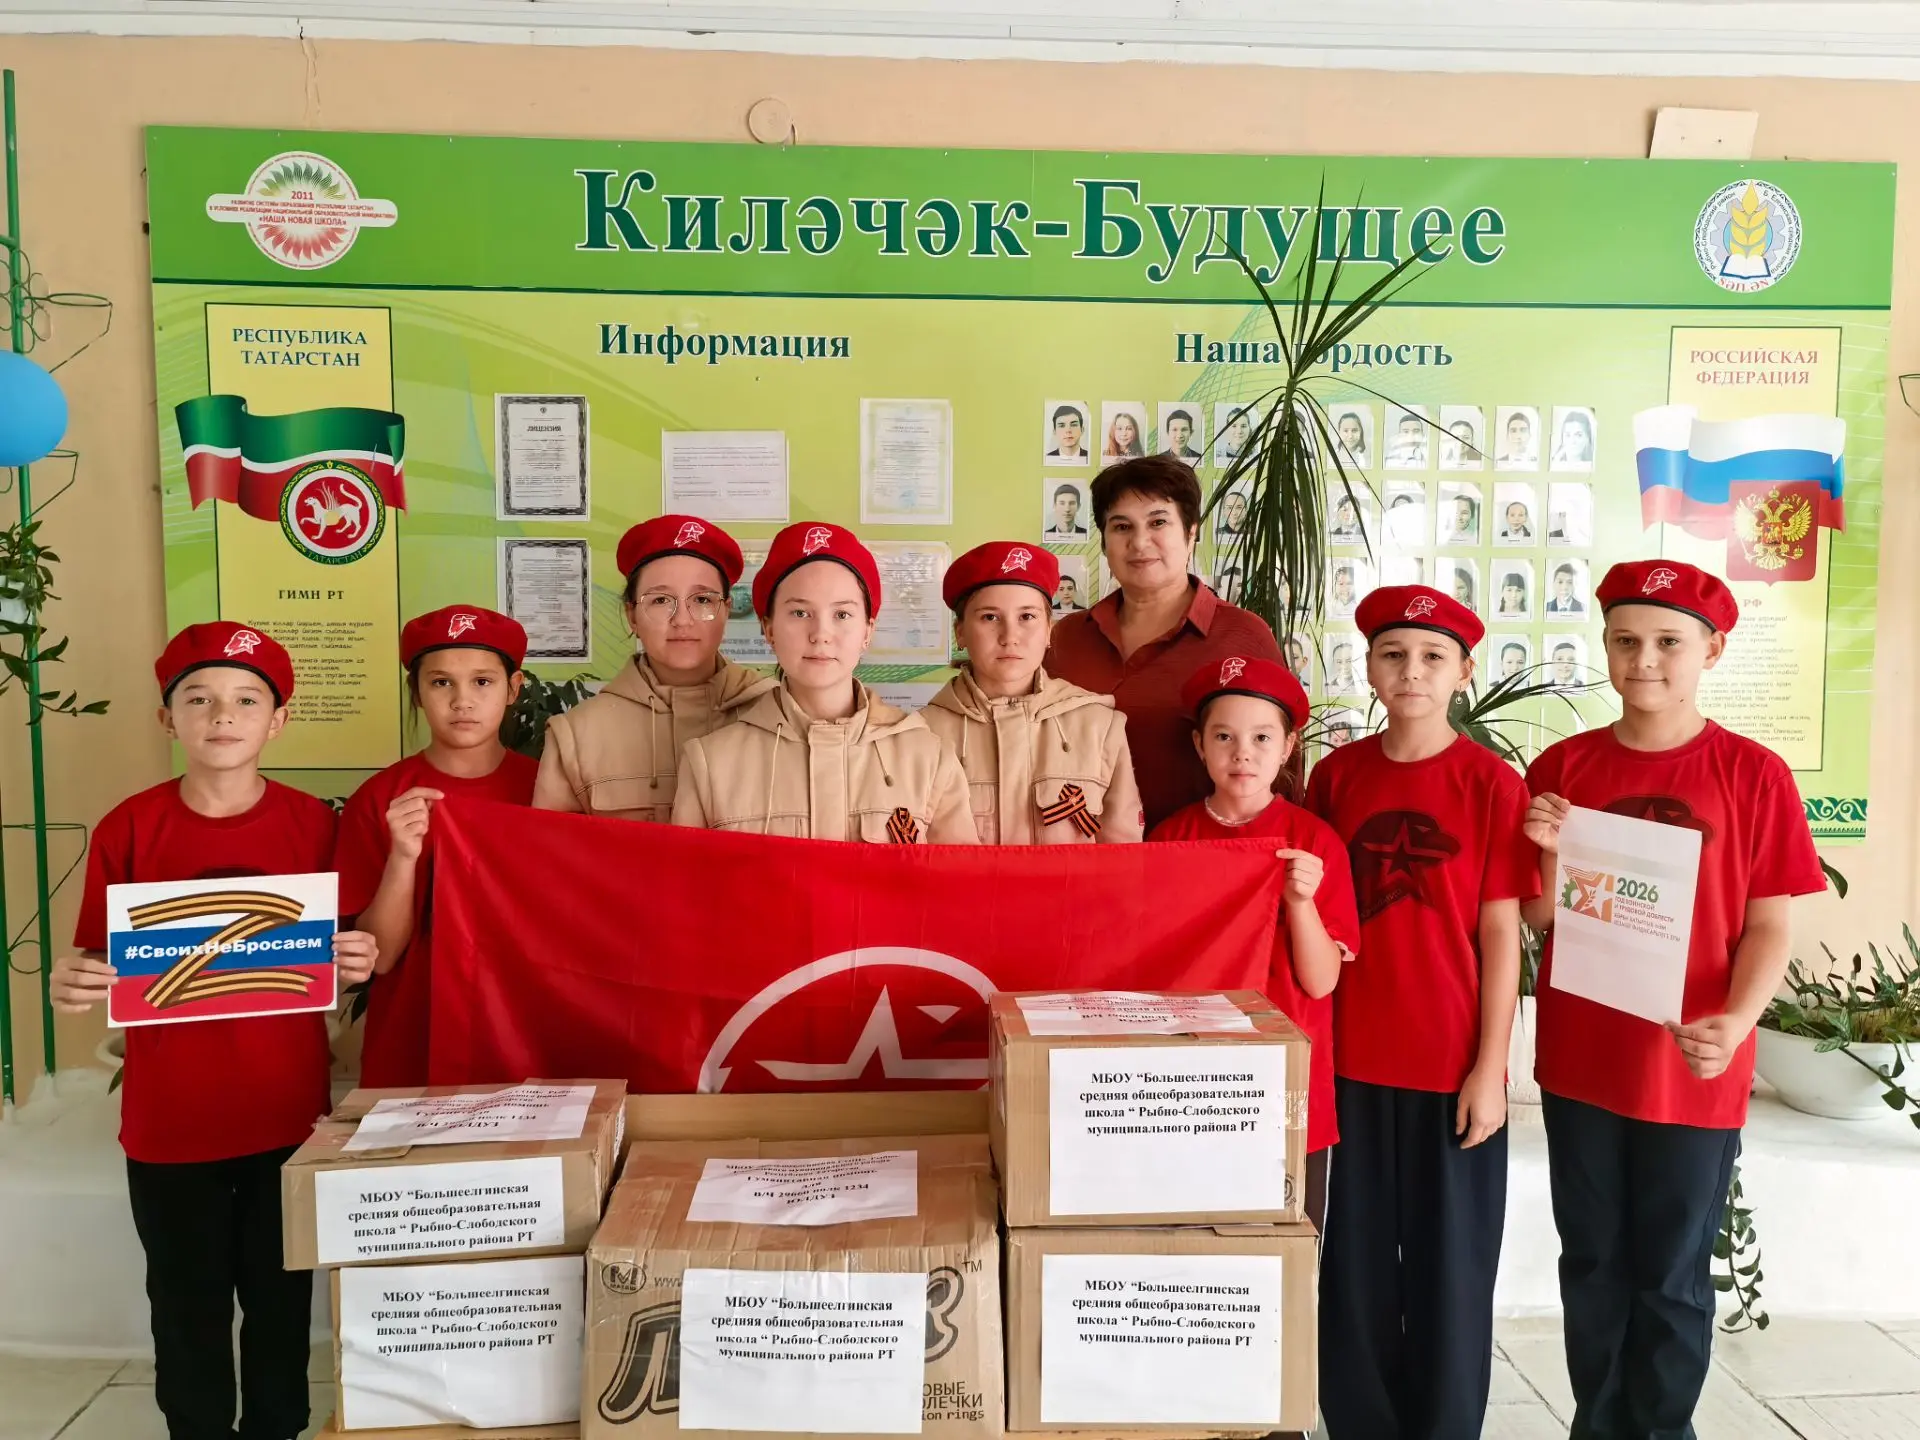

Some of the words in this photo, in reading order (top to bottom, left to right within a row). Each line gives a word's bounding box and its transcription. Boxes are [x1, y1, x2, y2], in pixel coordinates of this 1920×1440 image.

[291, 191, 314, 200] 2011
[259, 216, 286, 224] «НАША
[574, 168, 1506, 285] Киләчәк-Будущее
[232, 327, 368, 346] РЕСПУБЛИКА
[598, 322, 851, 366] Информация
[1174, 332, 1282, 364] Наша
[1690, 347, 1818, 365] РОССИЙСКАЯ
[240, 350, 361, 368] ТАТАРСТАН
[1696, 371, 1810, 386] ФЕДЕРАЦИЯ
[308, 550, 362, 564] ТАТАРСТАН
[278, 589, 321, 600] ГИМН
[327, 590, 345, 600] РТ
[1743, 598, 1763, 608] РФ
[1616, 877, 1659, 904] 2026
[1625, 898, 1655, 911] ВОИНСКОЙ
[1619, 904, 1646, 916] ТРУДОВОЙ
[1645, 911, 1674, 923] ДОБЛЕСТИ
[125, 937, 322, 960] #СвоихНеБросаем
[1091, 1072, 1133, 1084] МБОУ
[1079, 1090, 1129, 1103] средняя
[1131, 1087, 1265, 1102] общеобразовательная
[1085, 1108, 1125, 1118] школа
[1138, 1104, 1260, 1118] Рыбно-Слободского
[1087, 1123, 1191, 1137] муниципального
[1193, 1121, 1237, 1135] района
[1240, 1120, 1258, 1133] РТ
[844, 1183, 870, 1191] 1234
[360, 1190, 403, 1205] МБОУ
[348, 1208, 400, 1222] средняя
[402, 1198, 542, 1218] общеобразовательная
[353, 1226, 396, 1239] школа
[410, 1214, 538, 1235] Рыбно-Слободского
[356, 1237, 466, 1256] муниципального
[468, 1233, 514, 1248] района
[517, 1230, 535, 1243] РТ
[1085, 1279, 1127, 1292] МБОУ
[382, 1291, 425, 1303] МБОУ
[724, 1295, 768, 1309] МБОУ
[371, 1308, 420, 1321] средняя
[424, 1301, 562, 1318] общеобразовательная
[1072, 1297, 1121, 1310] средняя
[1125, 1298, 1261, 1314] общеобразовательная
[377, 1325, 417, 1336] школа
[431, 1318, 558, 1335] Рыбно-Слободского
[711, 1314, 761, 1328] средняя
[765, 1314, 904, 1330] общеобразовательная
[1077, 1315, 1118, 1326] школа
[1131, 1316, 1256, 1330] Рыбно-Слободского
[377, 1339, 486, 1356] муниципального
[489, 1336, 534, 1351] района
[537, 1333, 555, 1346] РТ
[715, 1334, 758, 1344] школа
[771, 1333, 899, 1346] Рыбно-Слободского
[1079, 1332, 1184, 1346] муниципального
[1187, 1334, 1231, 1348] района
[1235, 1335, 1252, 1347] РТ
[718, 1349, 826, 1363] муниципального
[828, 1349, 874, 1363] района
[877, 1348, 896, 1361] РТ
[922, 1393, 983, 1409] ЛЕЧКИ
[947, 1408, 984, 1421] rings
